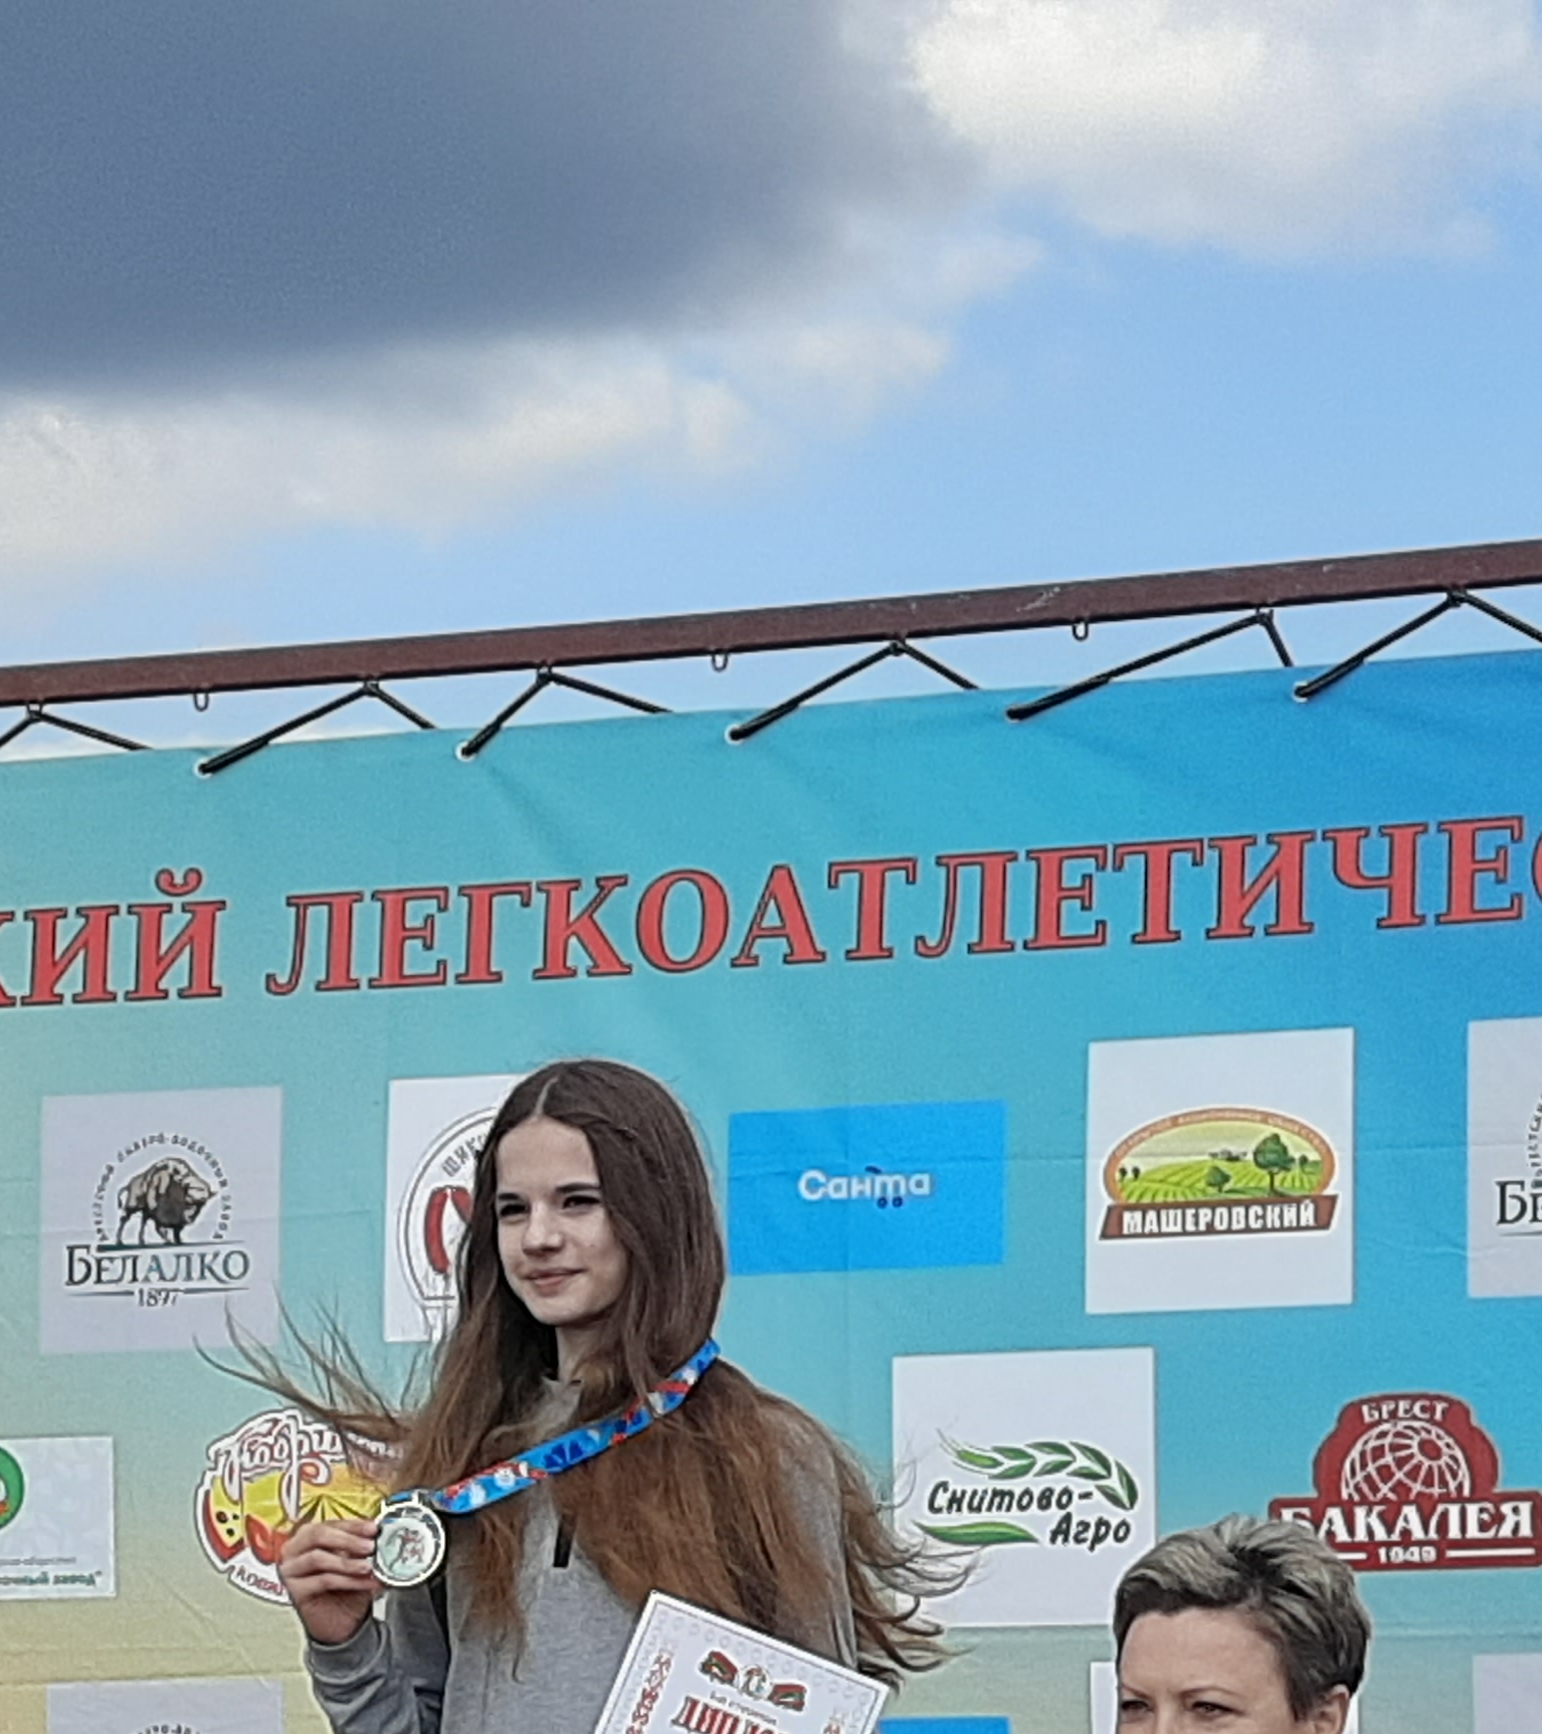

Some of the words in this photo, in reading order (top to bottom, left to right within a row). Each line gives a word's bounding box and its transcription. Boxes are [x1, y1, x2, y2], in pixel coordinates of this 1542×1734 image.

[798, 1169, 931, 1201] Санта
[1122, 1200, 1317, 1235] МАШЕРОВСКИЙ
[65, 1245, 250, 1286] БЕЛАЛКО
[137, 1288, 179, 1307] 1897
[1361, 1400, 1448, 1423] БРЕСТ
[927, 1480, 1093, 1514] Снитово-
[1049, 1512, 1132, 1552] Агро
